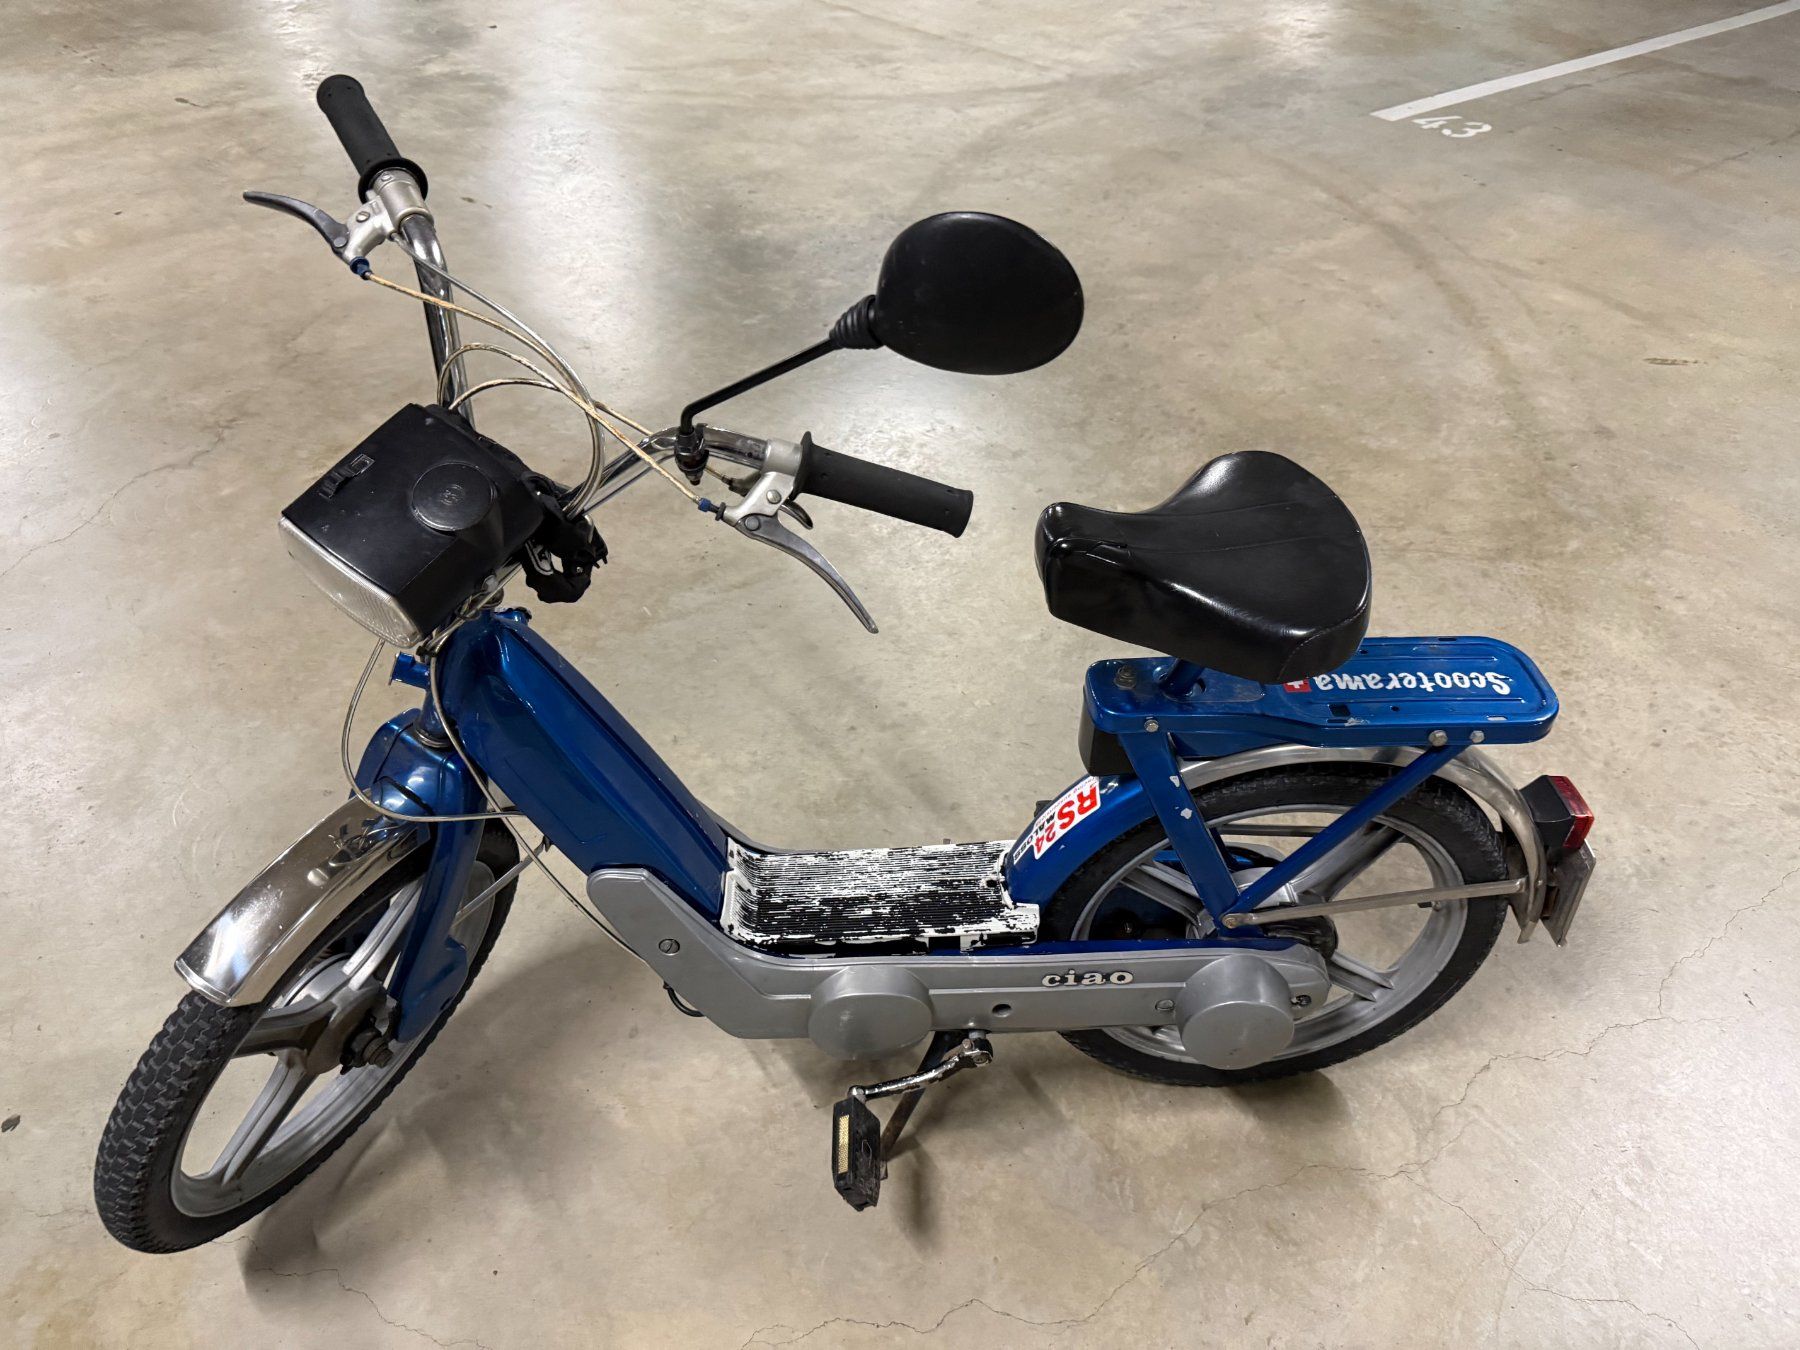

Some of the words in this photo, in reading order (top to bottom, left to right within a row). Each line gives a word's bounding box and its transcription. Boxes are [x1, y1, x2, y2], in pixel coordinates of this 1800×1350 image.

[1412, 115, 1492, 138] 43
[1313, 671, 1512, 695] Scooterama
[1041, 968, 1134, 987] ciao
